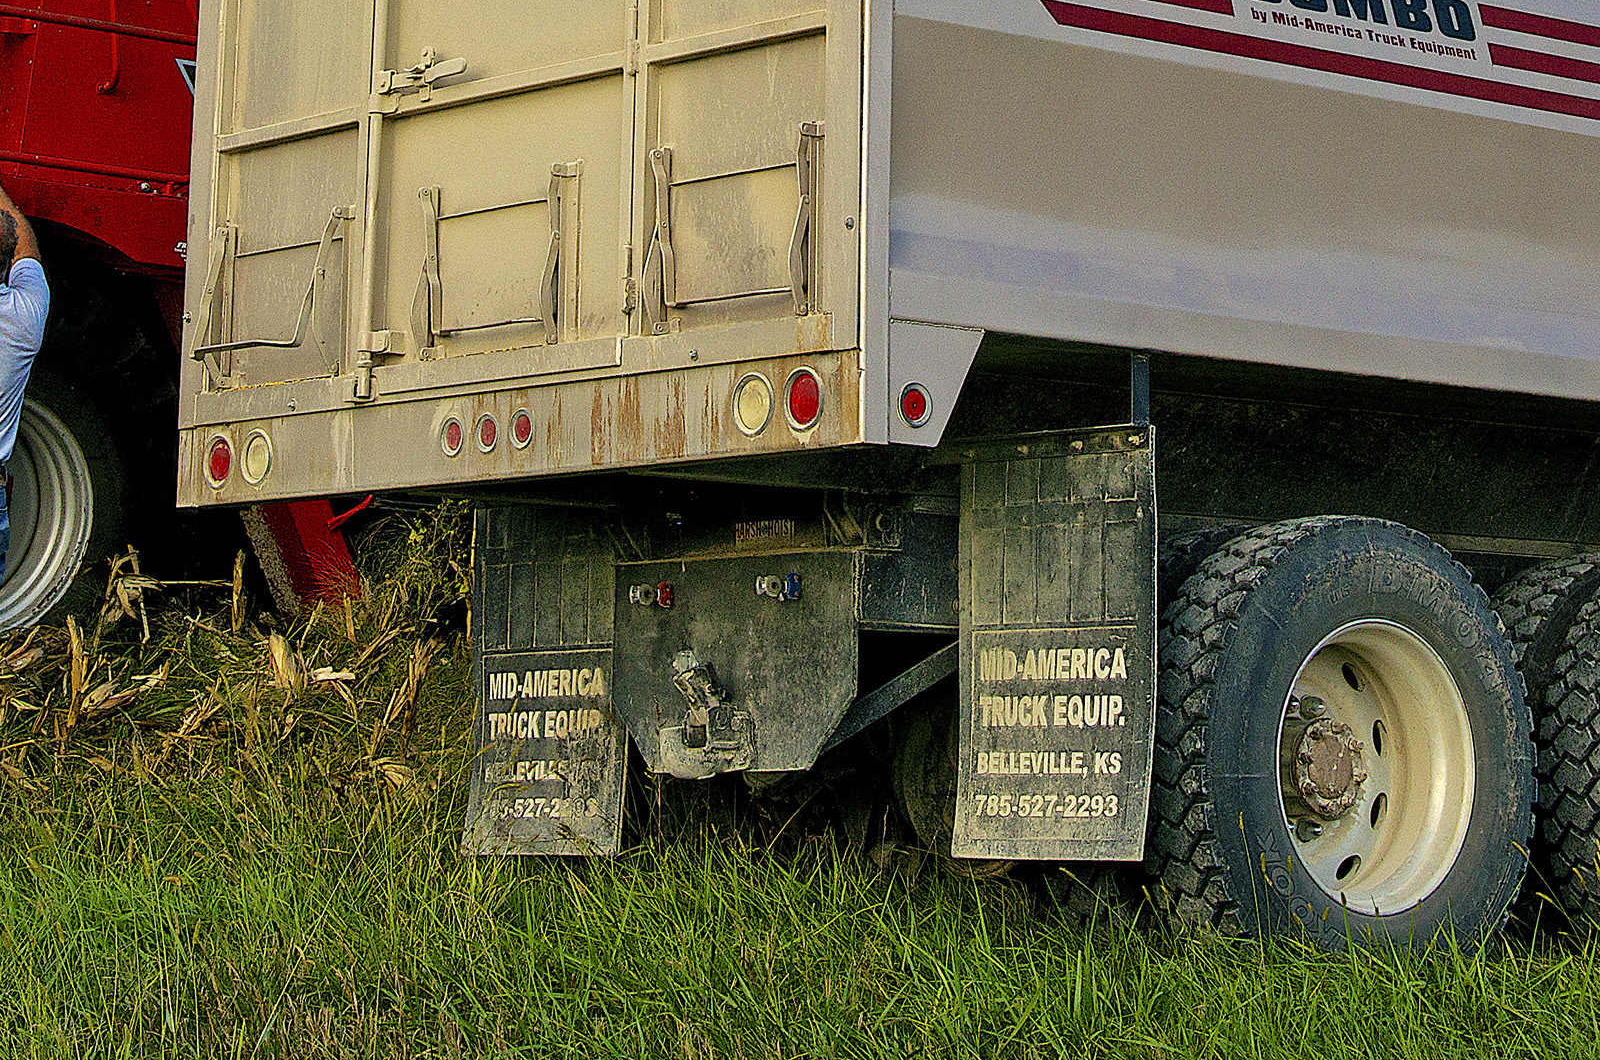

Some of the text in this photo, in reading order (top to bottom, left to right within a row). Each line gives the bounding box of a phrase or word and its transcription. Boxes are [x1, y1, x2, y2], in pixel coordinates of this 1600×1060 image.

[1251, 7, 1477, 61] by Mid-America Truck Equipment
[980, 647, 1128, 682] MID-AMERICA
[489, 668, 607, 700] MID-AMERICA
[488, 711, 541, 740] TRUCK
[979, 694, 1126, 729] TRUCK EQUIP.
[977, 751, 1123, 779] BELLEVILLE, KS
[975, 794, 1119, 818] 785-527-2293
